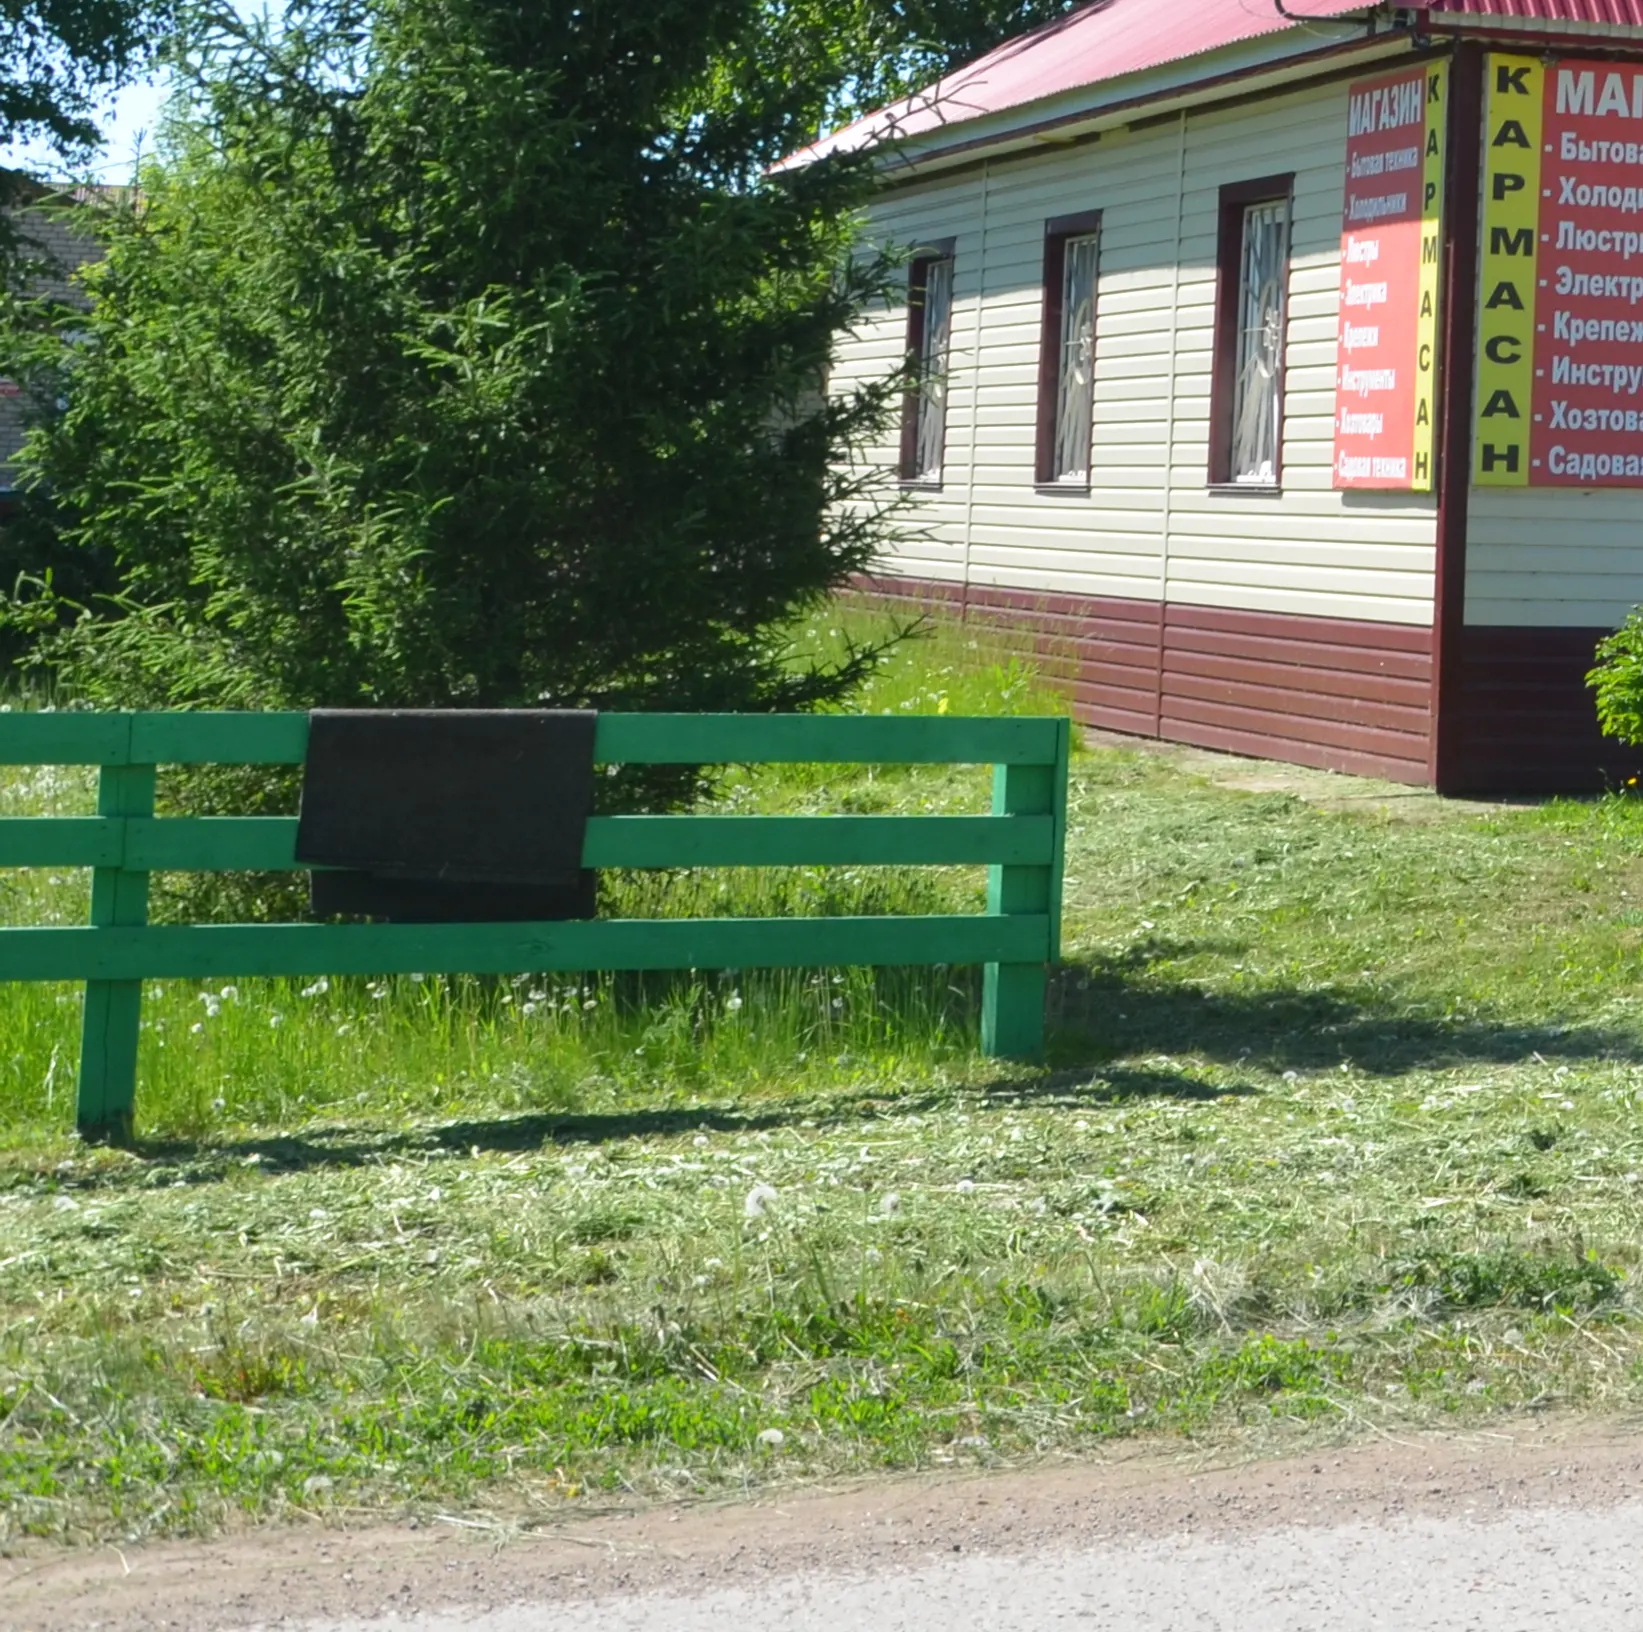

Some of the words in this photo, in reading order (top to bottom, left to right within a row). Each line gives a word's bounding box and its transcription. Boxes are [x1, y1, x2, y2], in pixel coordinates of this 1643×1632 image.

[1349, 79, 1422, 136] МАГАЗИН
[1415, 75, 1439, 479] КАРМАСАН
[1481, 66, 1534, 472] КАРМАСАН
